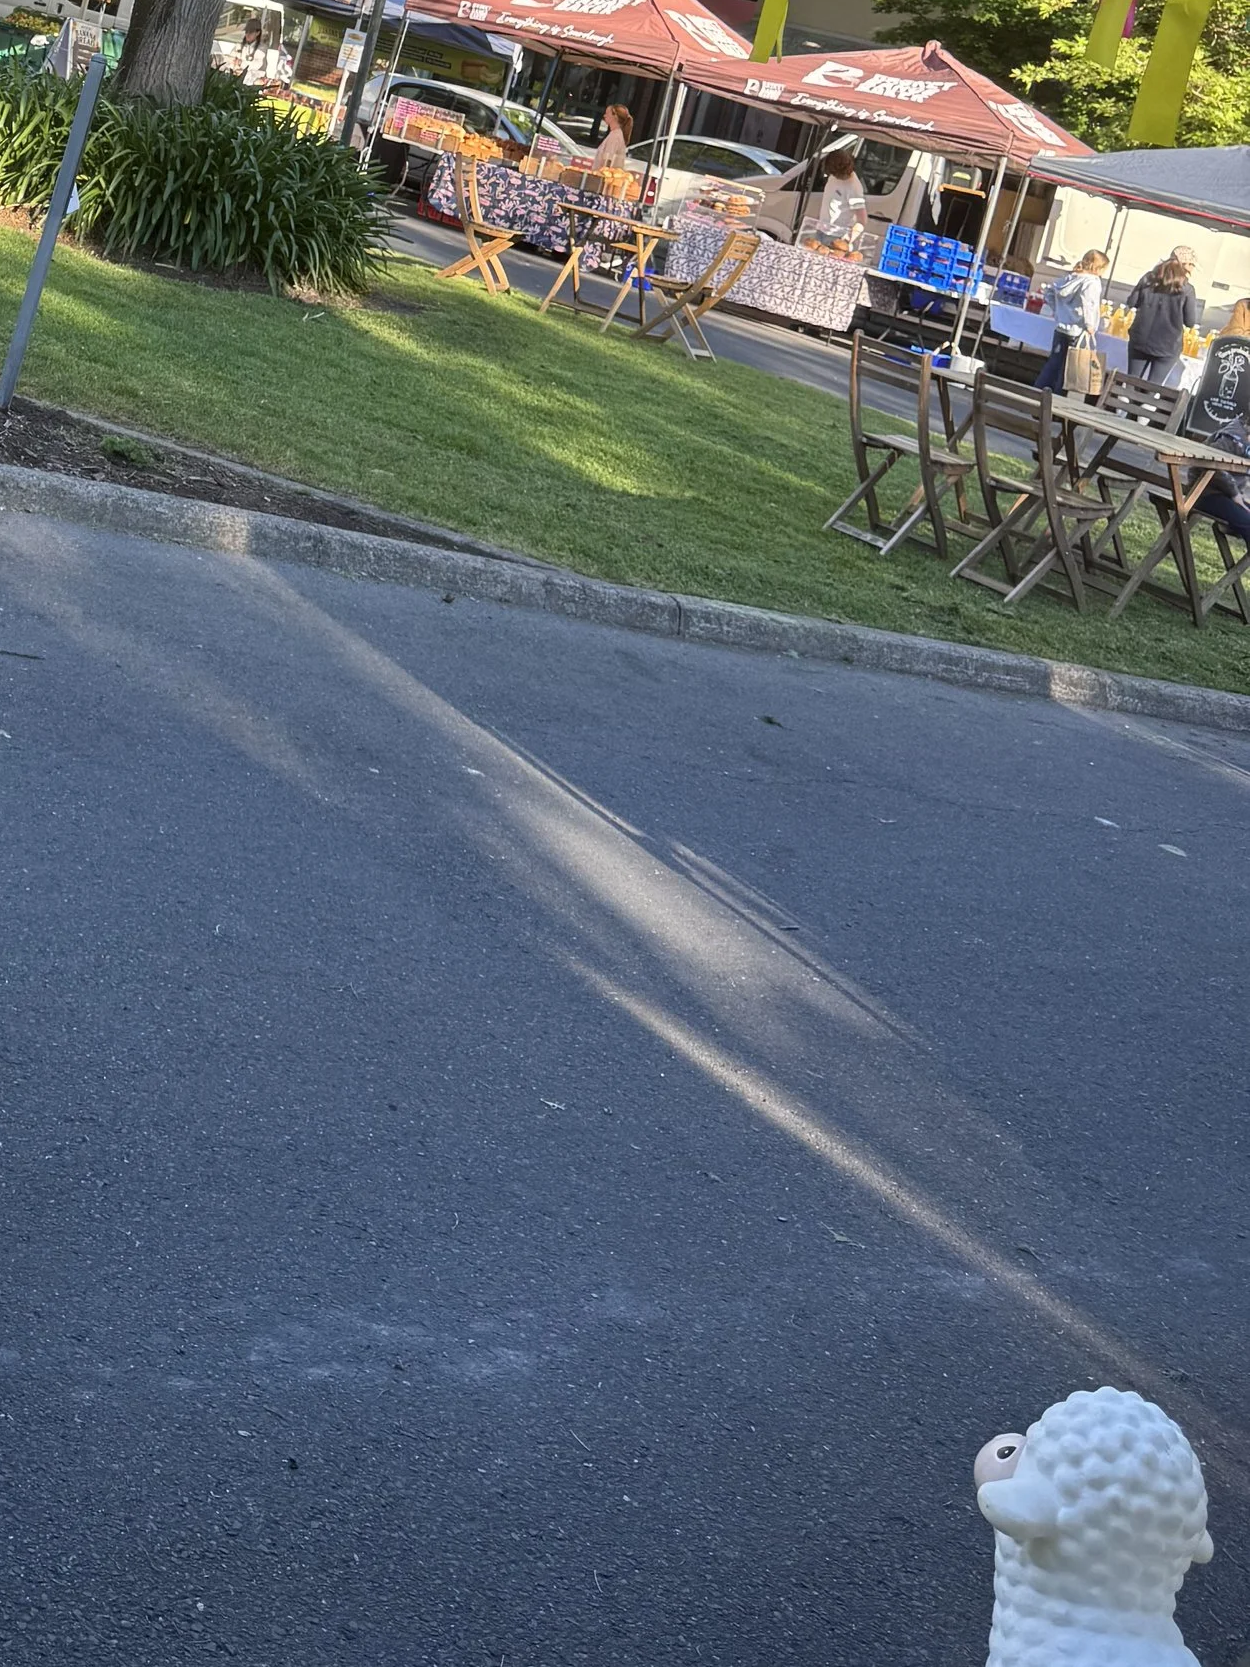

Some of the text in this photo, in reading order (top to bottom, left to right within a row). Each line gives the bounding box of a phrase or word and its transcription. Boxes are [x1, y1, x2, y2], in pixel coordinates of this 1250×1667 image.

[496, 11, 550, 35] Everything
[551, 25, 562, 35] is
[560, 24, 614, 47] Sourdough
[790, 92, 857, 118] Everything
[857, 108, 871, 120] is
